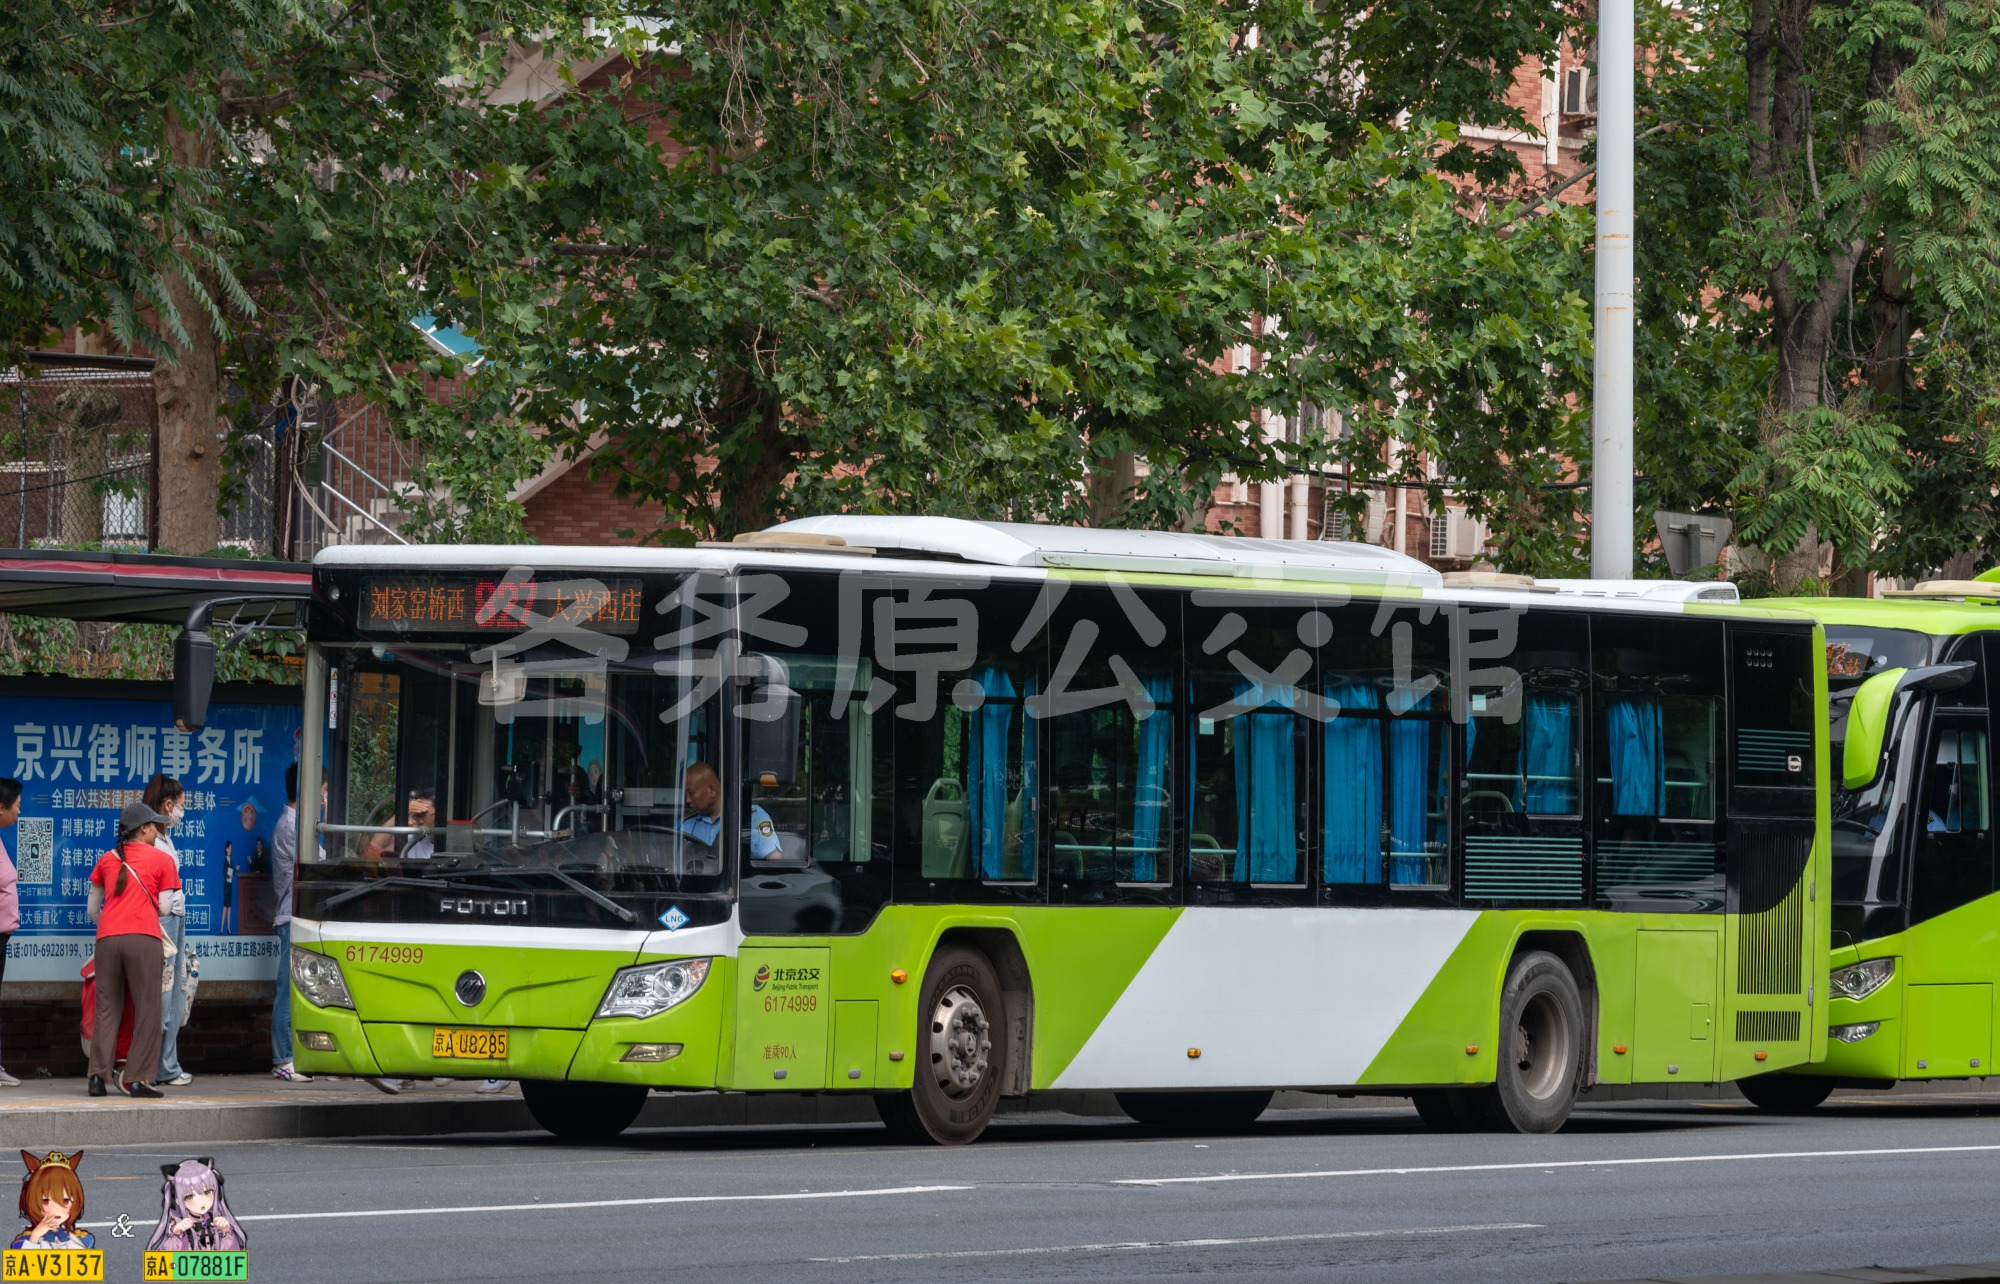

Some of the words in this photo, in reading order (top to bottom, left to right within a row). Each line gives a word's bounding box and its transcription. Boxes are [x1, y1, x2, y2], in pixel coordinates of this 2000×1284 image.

[371, 586, 465, 621] 刘家窑桥西
[475, 582, 538, 628] 827
[547, 587, 642, 623] 大兴西庄
[13, 722, 264, 785] 京兴律师事务所
[61, 818, 106, 838] 刑事辩护
[180, 878, 206, 897] 见证
[440, 899, 528, 915] FOTON
[66, 909, 95, 926] 专业律
[665, 915, 684, 923] LNG
[6, 942, 96, 959] 电话:010-69228199、13
[345, 945, 424, 964] 6174999
[772, 968, 820, 981] 北京公交
[772, 983, 785, 992] Beijing
[764, 995, 817, 1012] 6174999
[763, 1043, 797, 1060] 准乘90人
